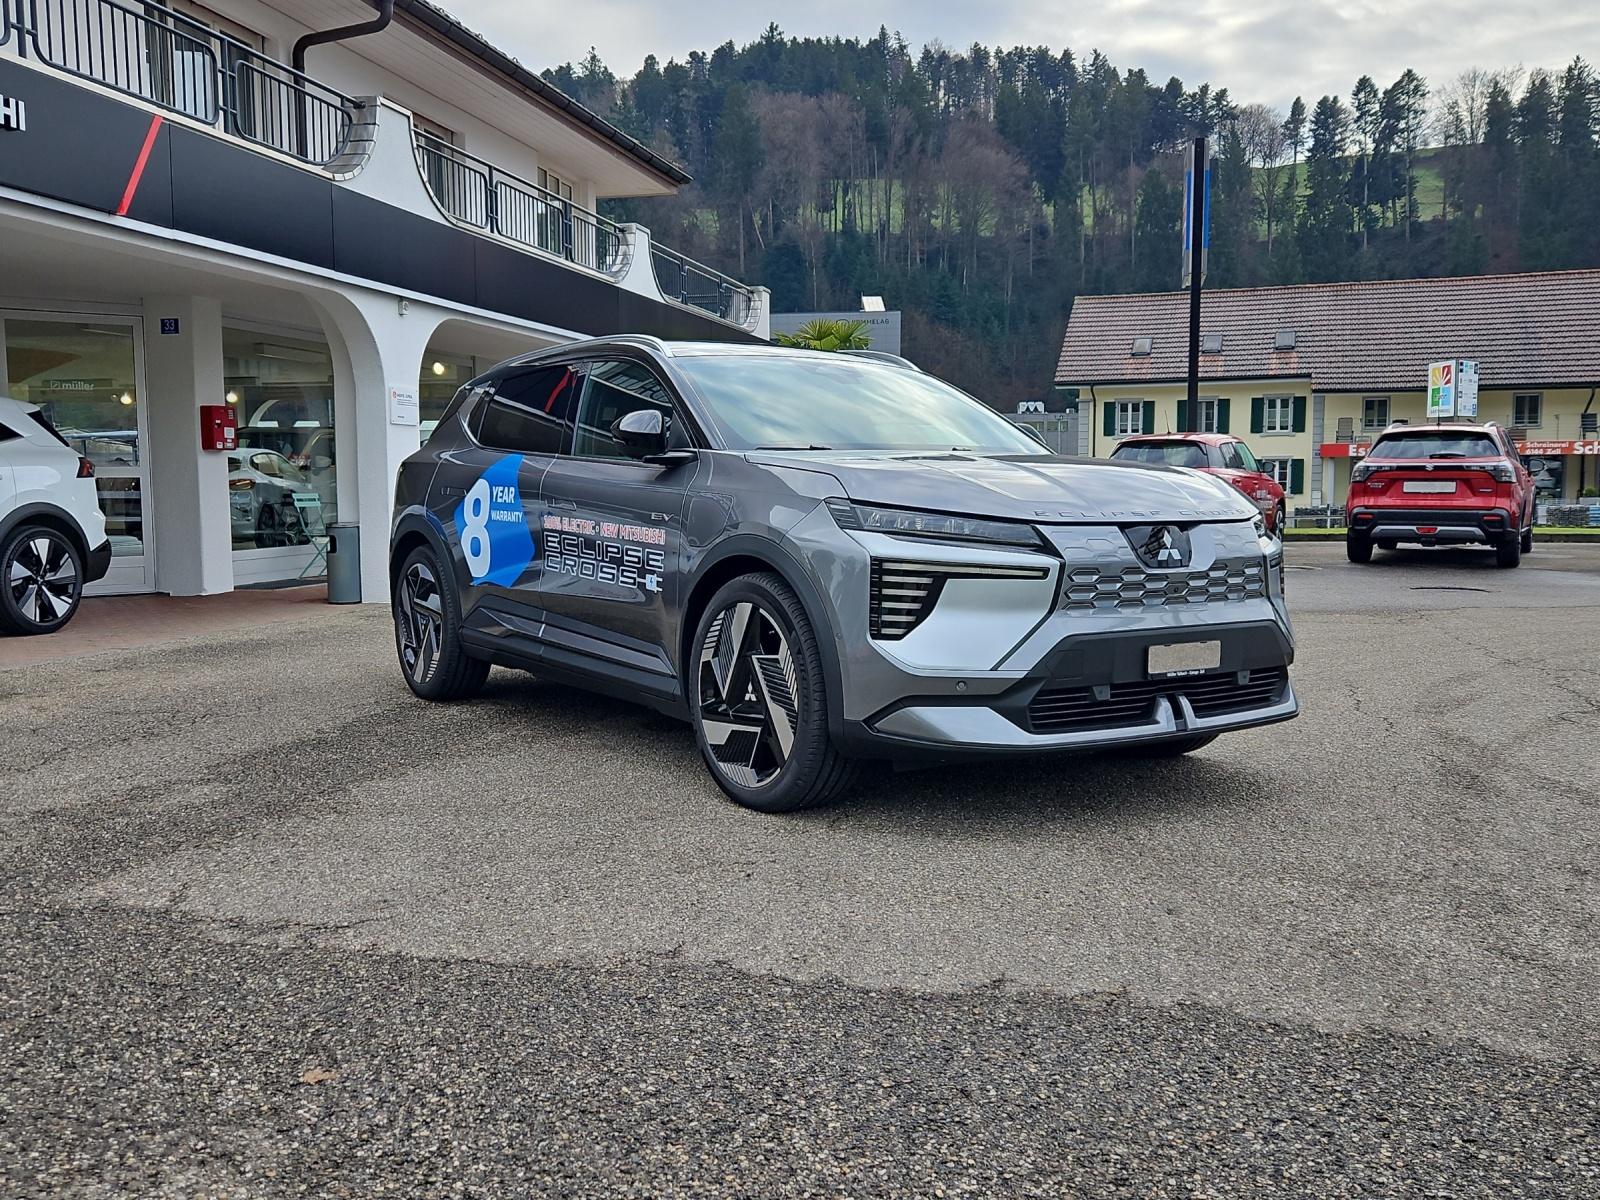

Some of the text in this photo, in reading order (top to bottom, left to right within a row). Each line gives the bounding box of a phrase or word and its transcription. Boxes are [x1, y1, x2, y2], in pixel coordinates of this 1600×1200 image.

[164, 319, 175, 330] 33
[62, 380, 95, 391] müller
[1349, 444, 1369, 457] Es
[492, 486, 516, 504] YEAR
[491, 510, 523, 523] WARRANTY
[651, 512, 675, 521] EV
[1034, 509, 1163, 518] ECLIPSE
[461, 478, 491, 577] 8
[562, 517, 596, 536] ELECTRIC
[600, 521, 619, 539] NEW
[619, 524, 666, 545] MITSUBISHI
[543, 531, 665, 572] ECLIPSE
[544, 551, 639, 589] CROSS
